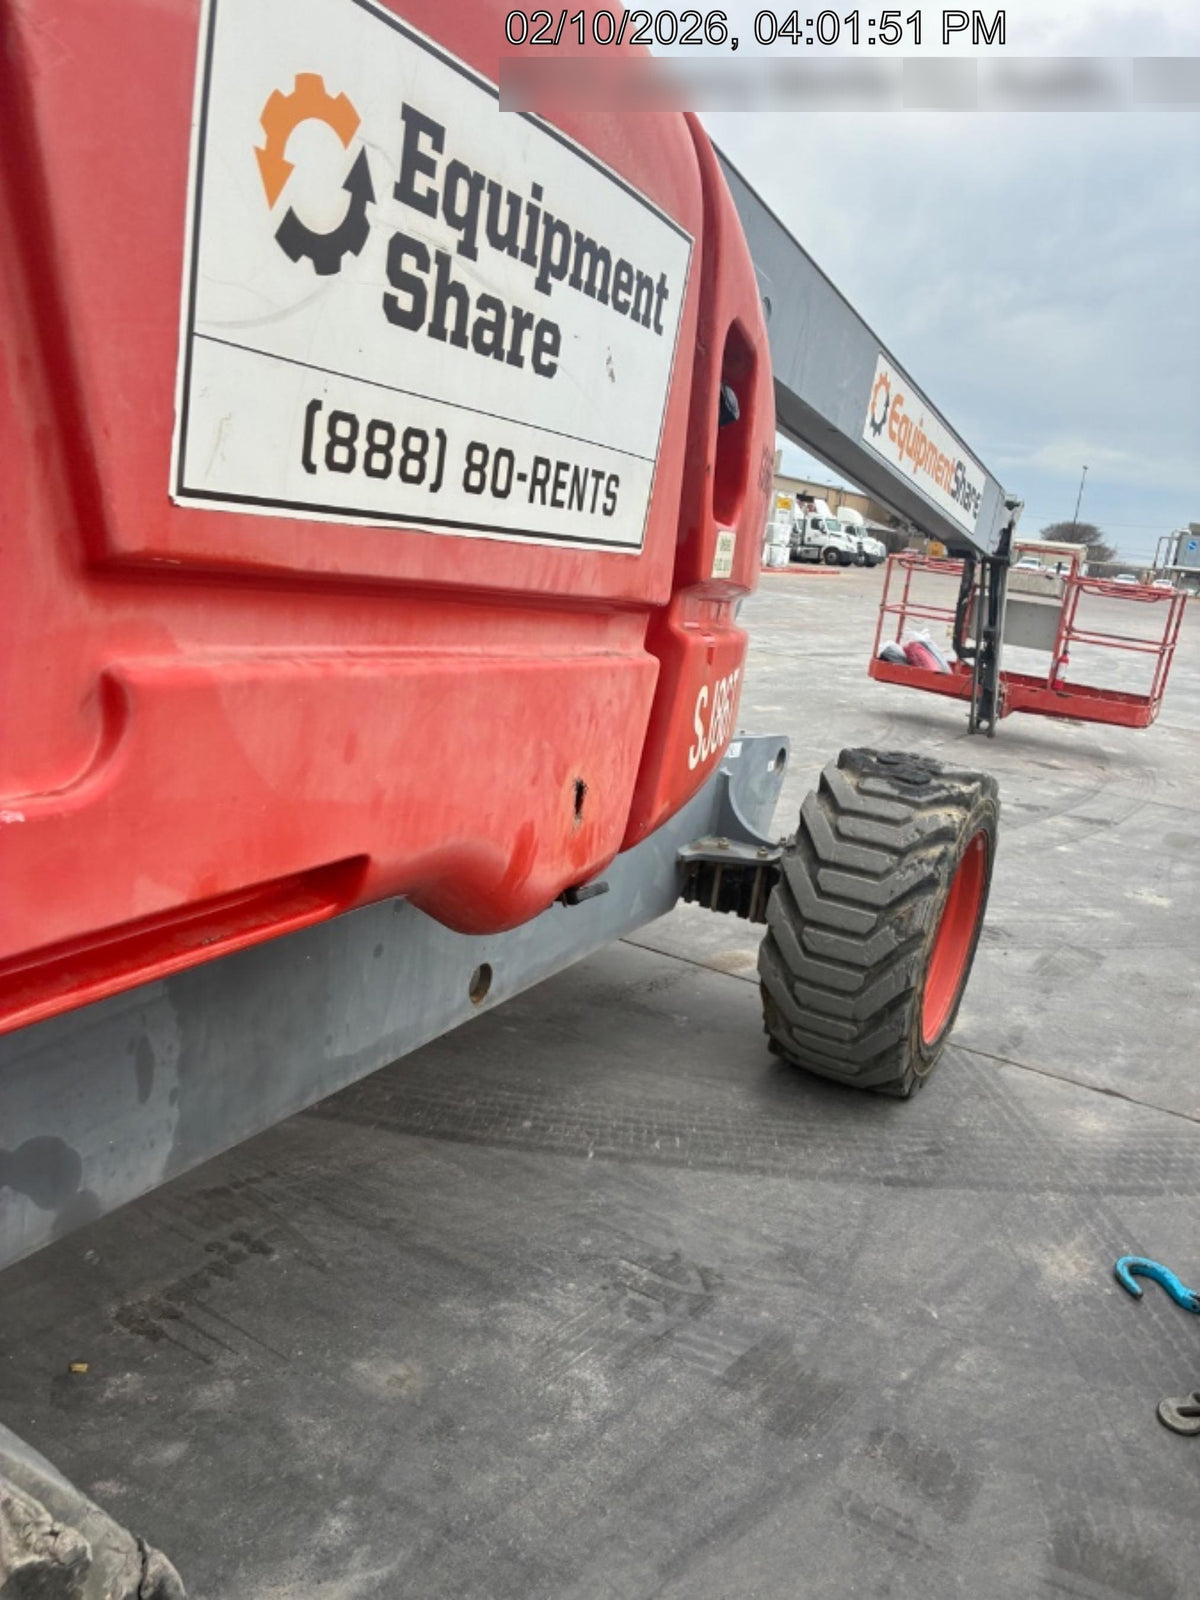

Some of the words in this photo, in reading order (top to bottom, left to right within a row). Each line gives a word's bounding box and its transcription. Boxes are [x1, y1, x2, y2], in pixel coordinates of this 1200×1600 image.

[393, 102, 669, 336] Equipment
[382, 231, 562, 379] Share
[301, 398, 447, 493] (888)
[462, 440, 620, 517] 80-RENTS
